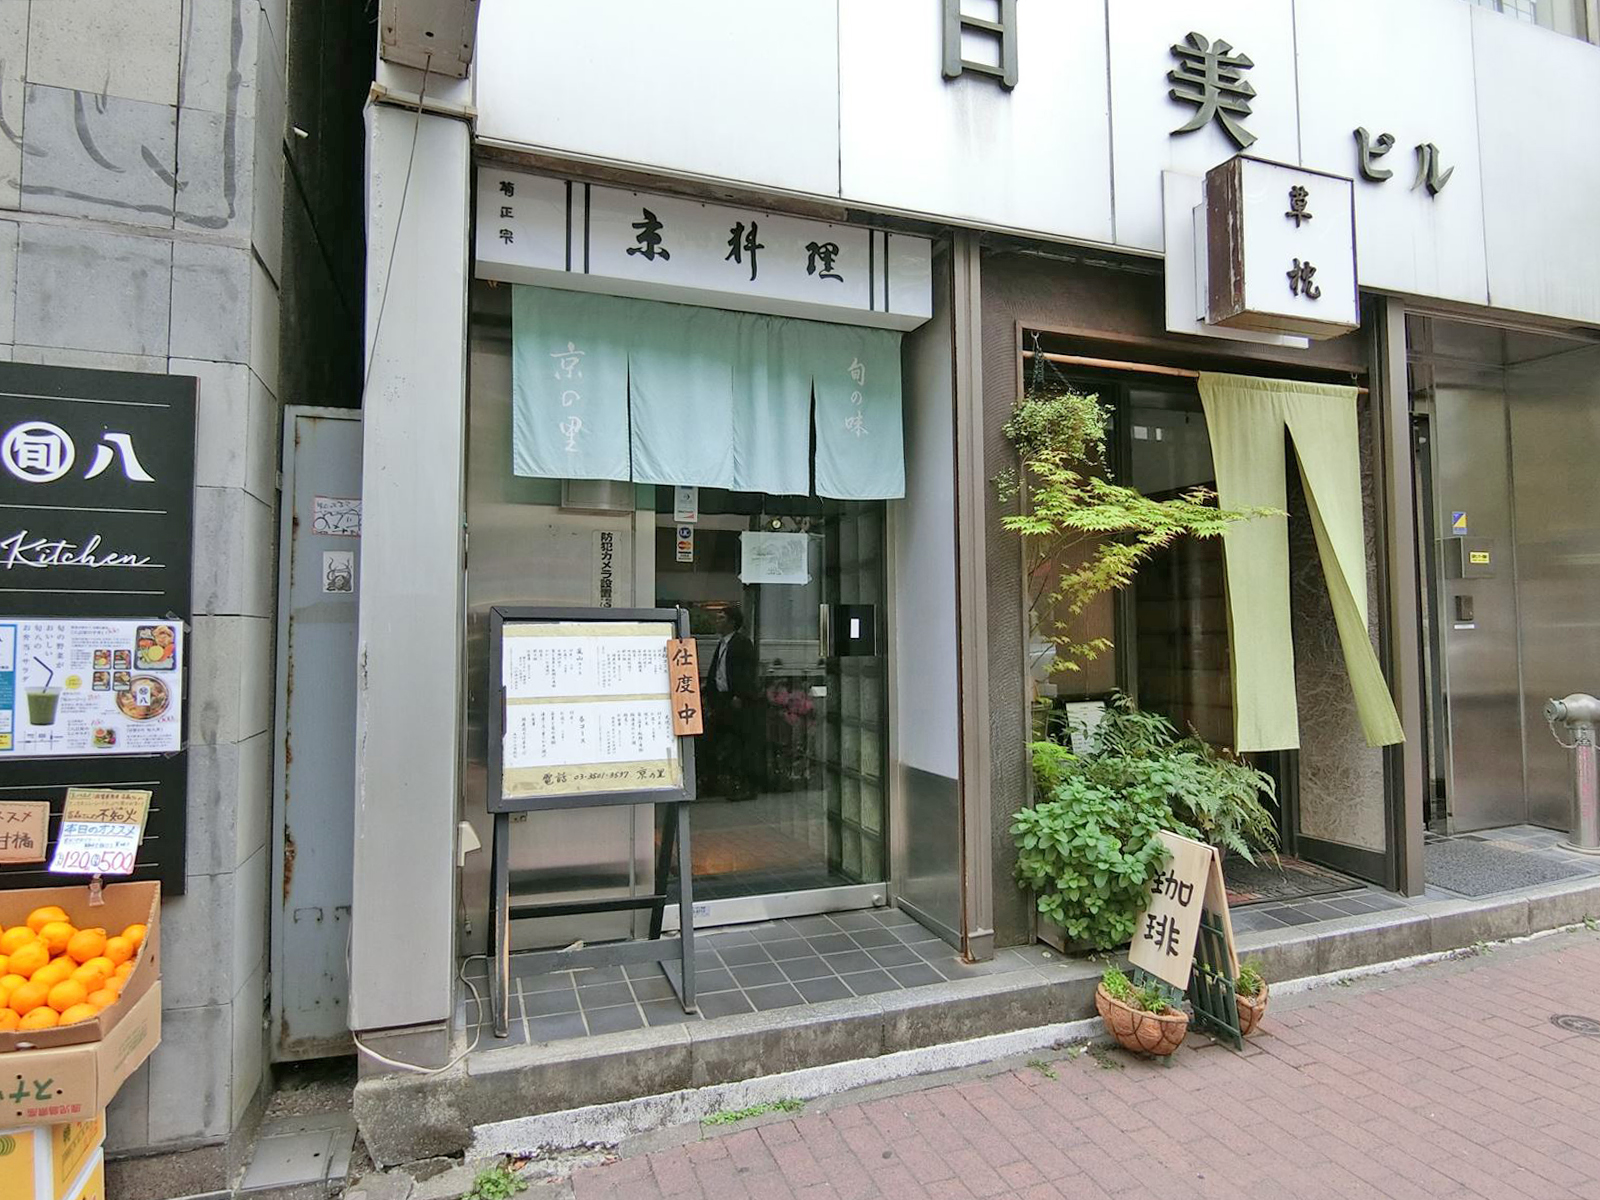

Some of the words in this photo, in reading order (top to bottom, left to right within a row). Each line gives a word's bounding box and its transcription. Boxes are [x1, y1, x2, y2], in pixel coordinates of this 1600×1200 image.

[626, 208, 844, 282] 京料理
[1285, 185, 1321, 300] 草枕
[550, 341, 586, 453] 京の里
[846, 358, 869, 438] 旬の味
[2, 421, 156, 483] 旬八
[1, 530, 151, 569] Kitchen
[673, 648, 697, 725] 仕度中
[64, 824, 136, 836] 本日のオススメ
[98, 851, 134, 872] 500
[1144, 869, 1194, 957] 珈琲
[0, 1078, 54, 1104] スナ
